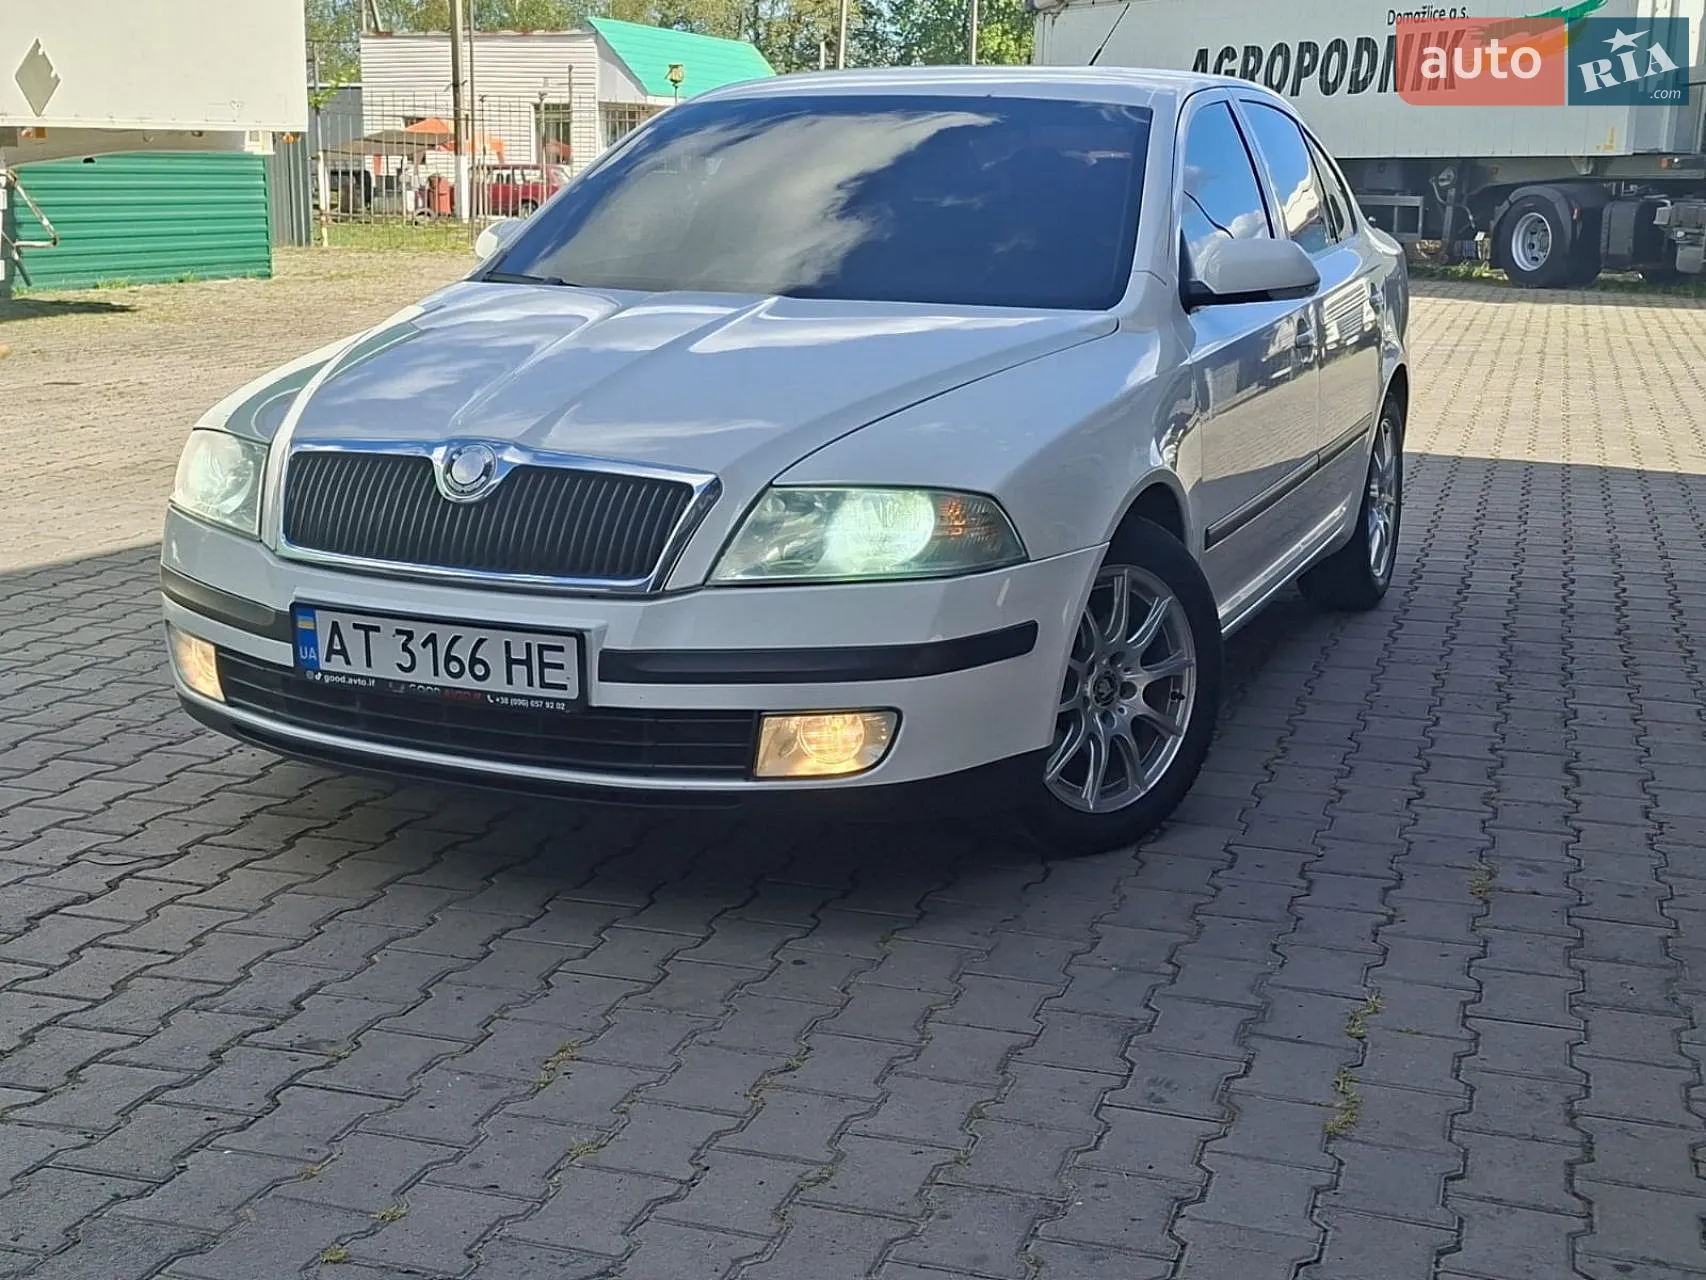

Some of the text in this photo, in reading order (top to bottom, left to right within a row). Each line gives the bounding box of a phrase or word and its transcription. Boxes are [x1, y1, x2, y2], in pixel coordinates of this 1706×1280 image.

[300, 645, 317, 661] UA
[324, 620, 568, 691] AT 3166 HE
